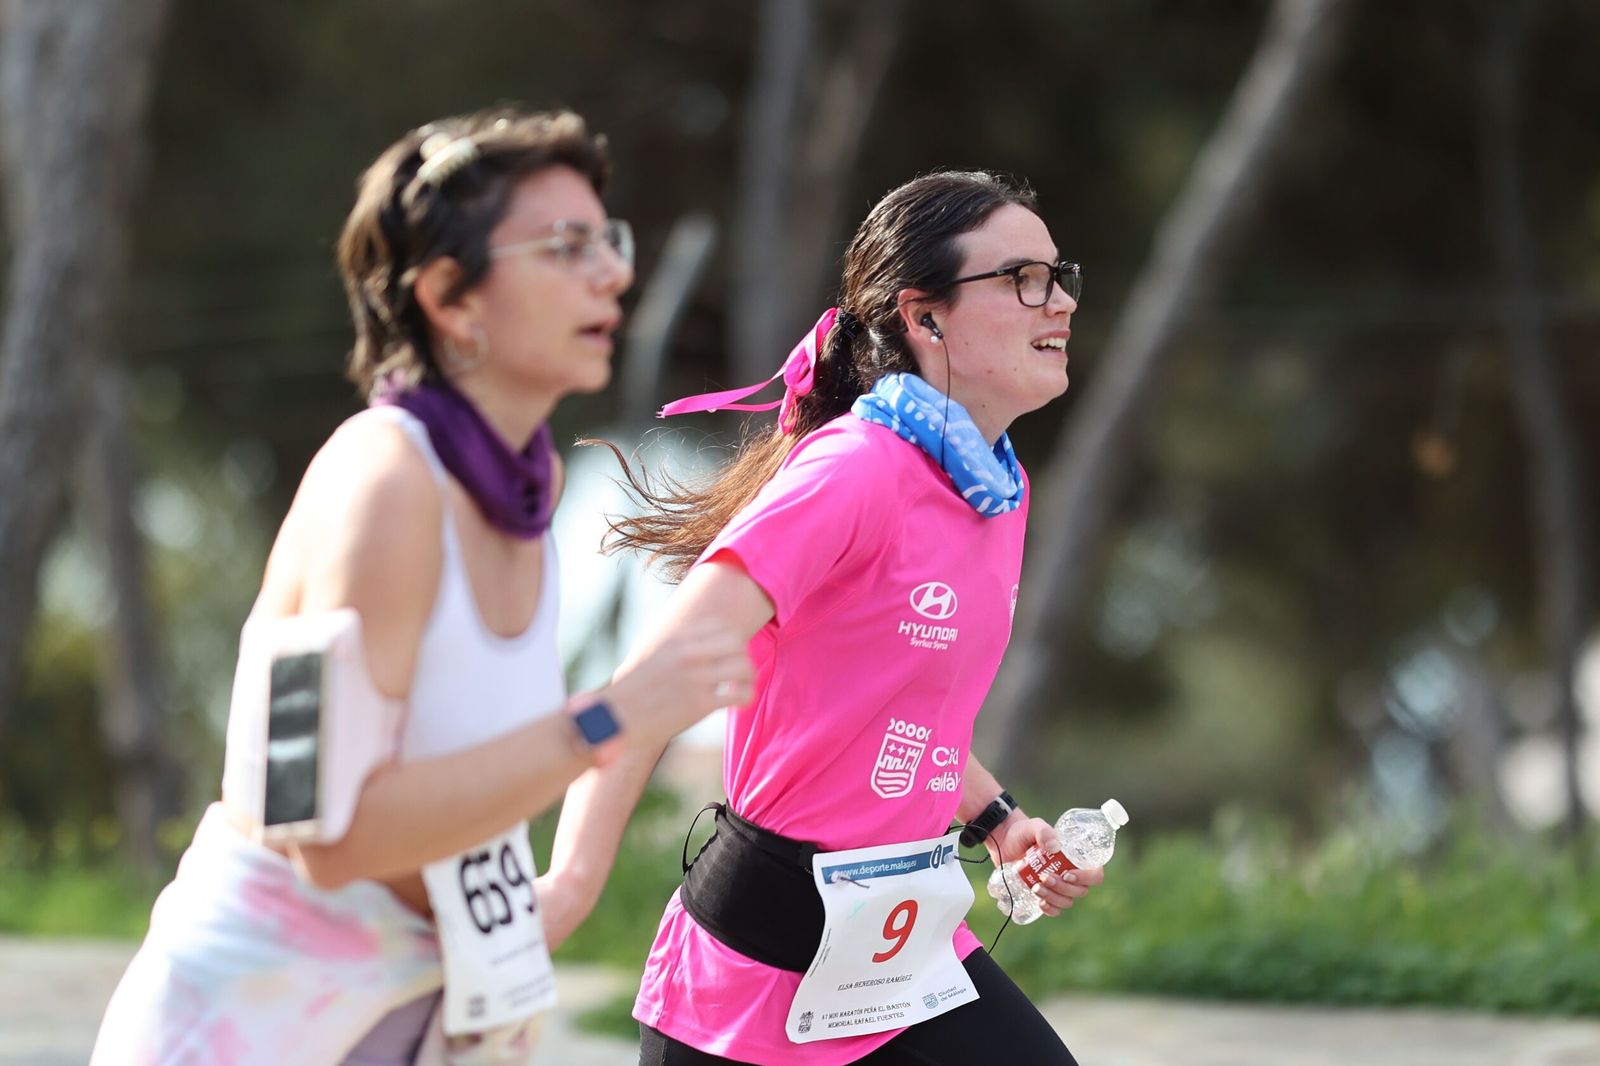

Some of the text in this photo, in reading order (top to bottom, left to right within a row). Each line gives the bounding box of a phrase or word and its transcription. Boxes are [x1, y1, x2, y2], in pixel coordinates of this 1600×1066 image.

[897, 620, 959, 642] HYUNDAI
[460, 843, 536, 935] 659
[872, 899, 919, 964] 9
[886, 1001, 911, 1011] BASTÓN
[854, 1016, 877, 1025] RAFAEL
[877, 1012, 905, 1022] FUENTES
